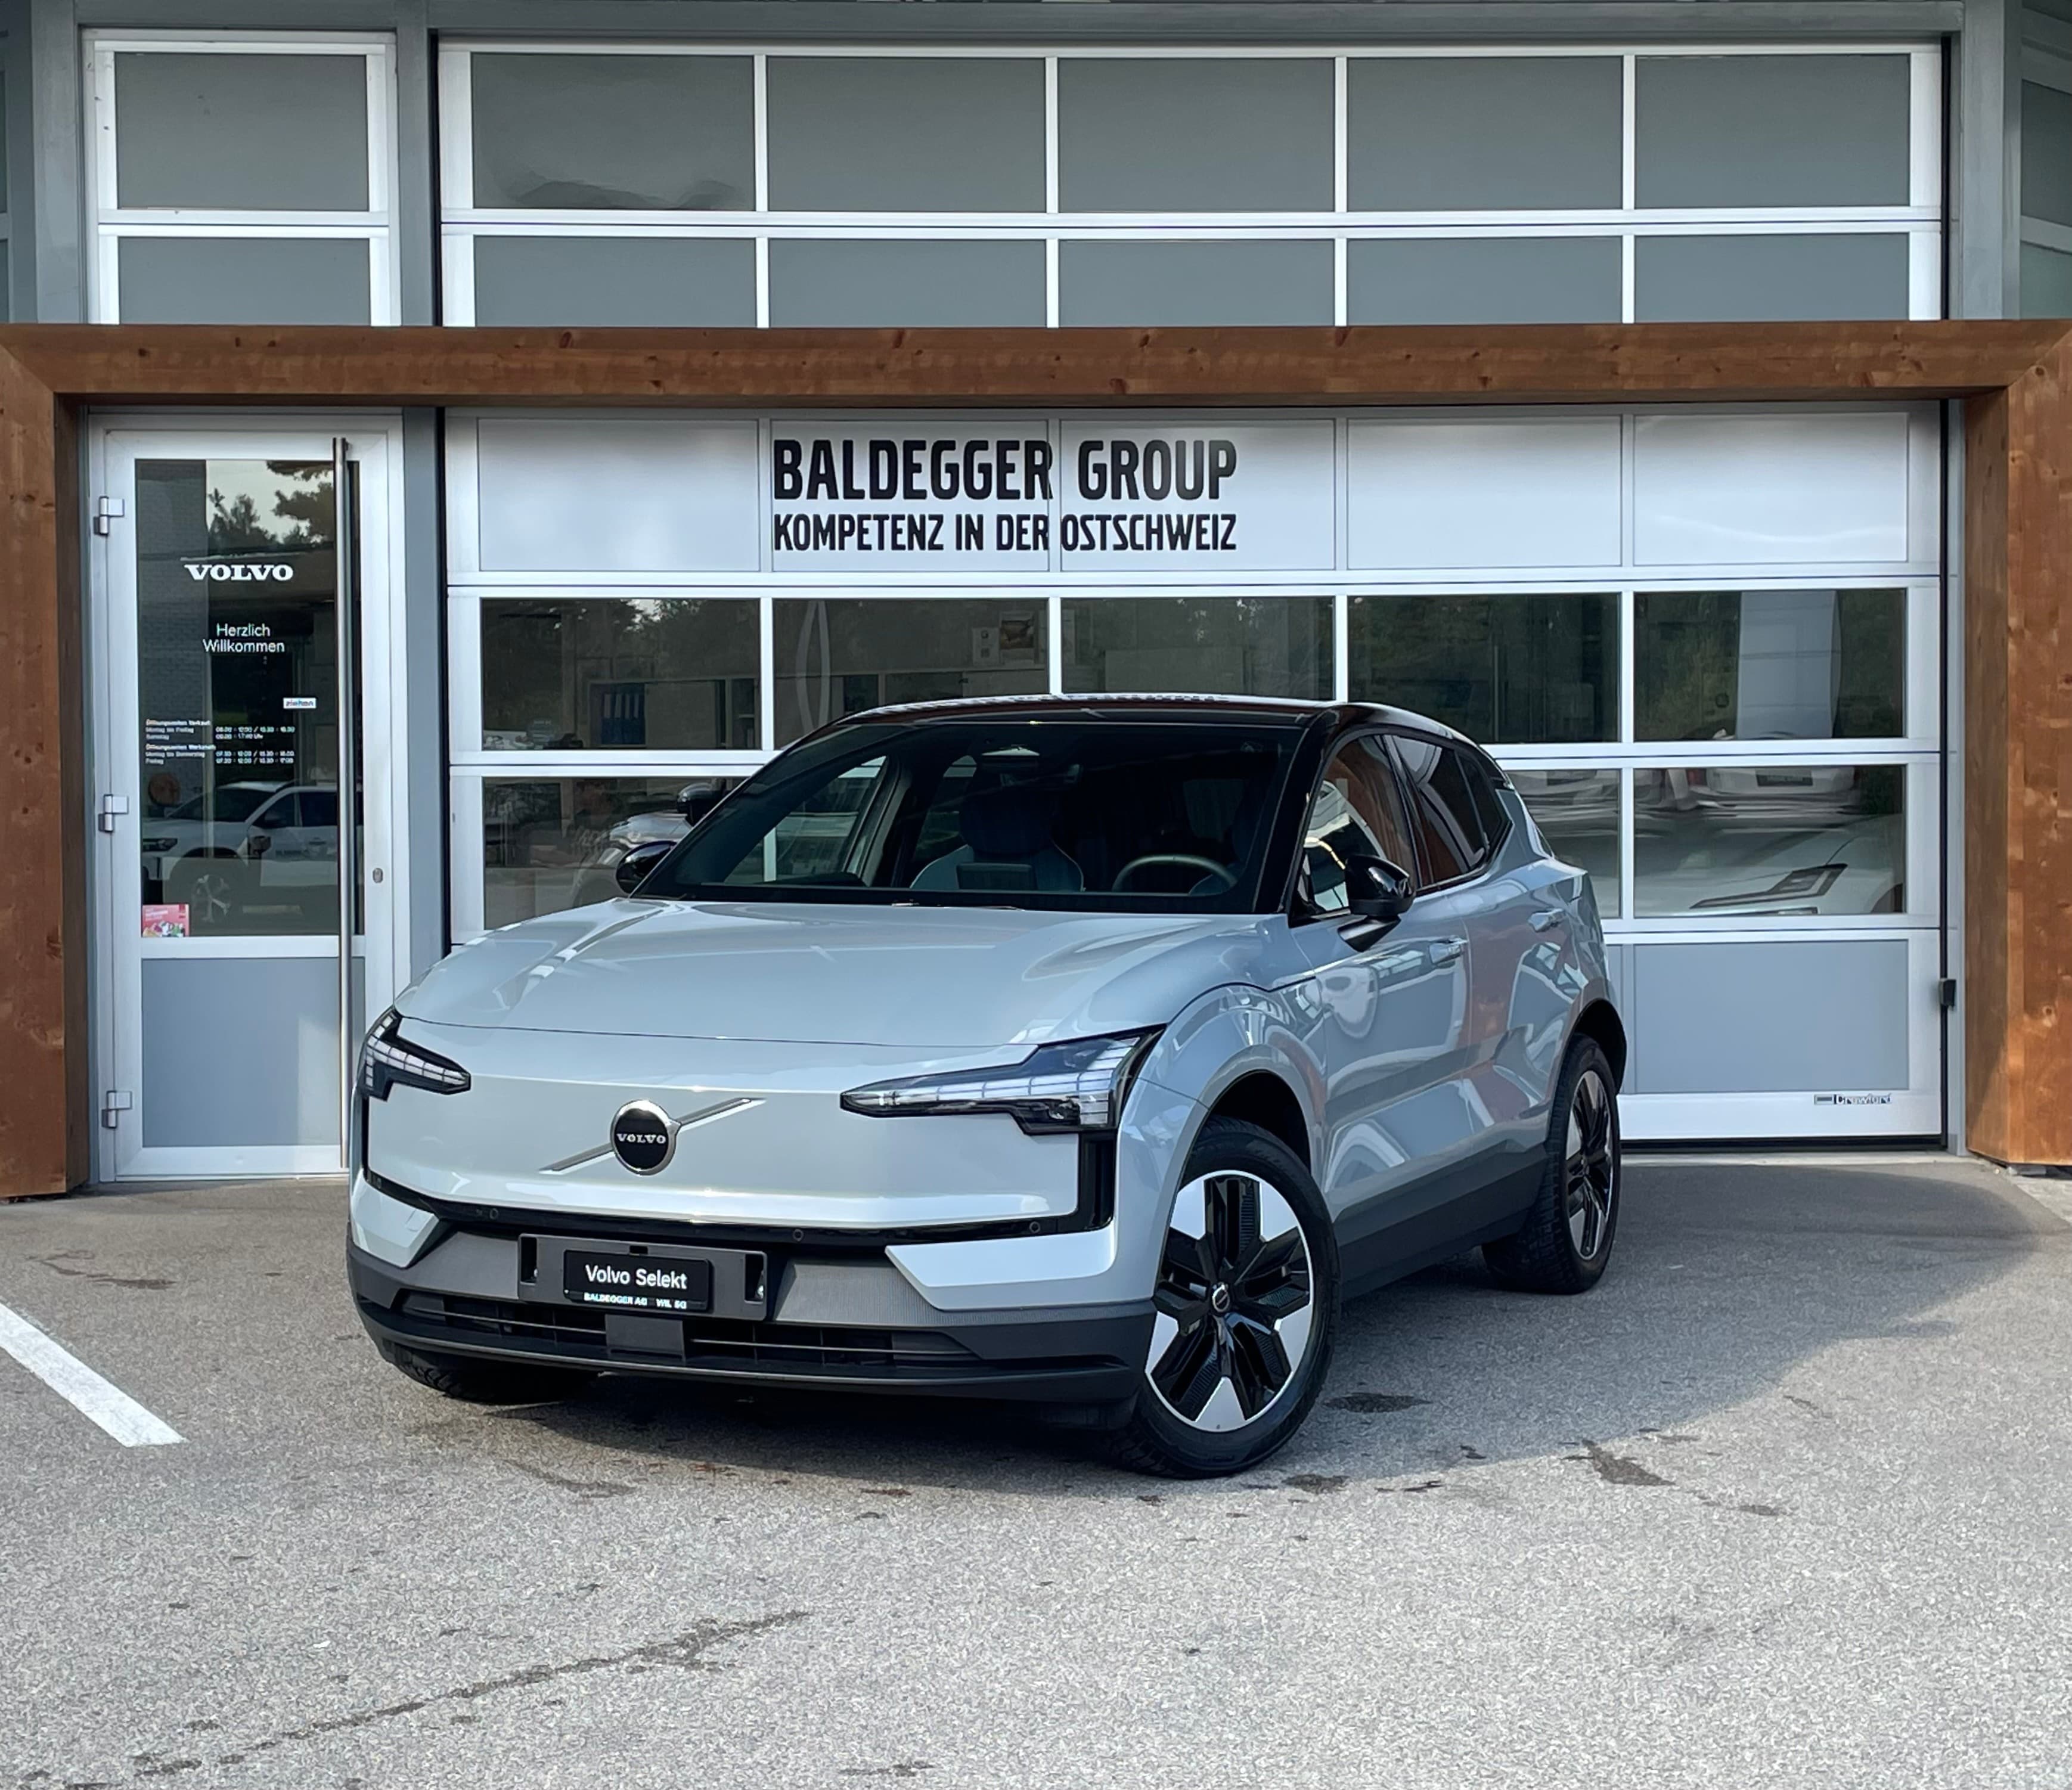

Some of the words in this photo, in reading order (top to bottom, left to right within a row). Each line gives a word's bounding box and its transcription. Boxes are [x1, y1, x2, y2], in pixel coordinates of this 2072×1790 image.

[774, 440, 1053, 500] BALDEGGER
[1078, 440, 1237, 500] GROUP
[774, 514, 944, 551] KOMPETENZ
[956, 514, 984, 551] IN
[996, 514, 1049, 551] DER
[1060, 514, 1236, 551] OSTSCHWEIZ
[184, 564, 293, 581] VOLVO
[216, 623, 271, 637] Herzlich
[202, 639, 285, 653] Willkommen
[616, 1134, 666, 1144] VOLVO
[585, 1264, 631, 1285] Volvo
[635, 1268, 687, 1289] Selekt
[584, 1292, 633, 1305] BALDEGGER
[634, 1296, 648, 1306] AG
